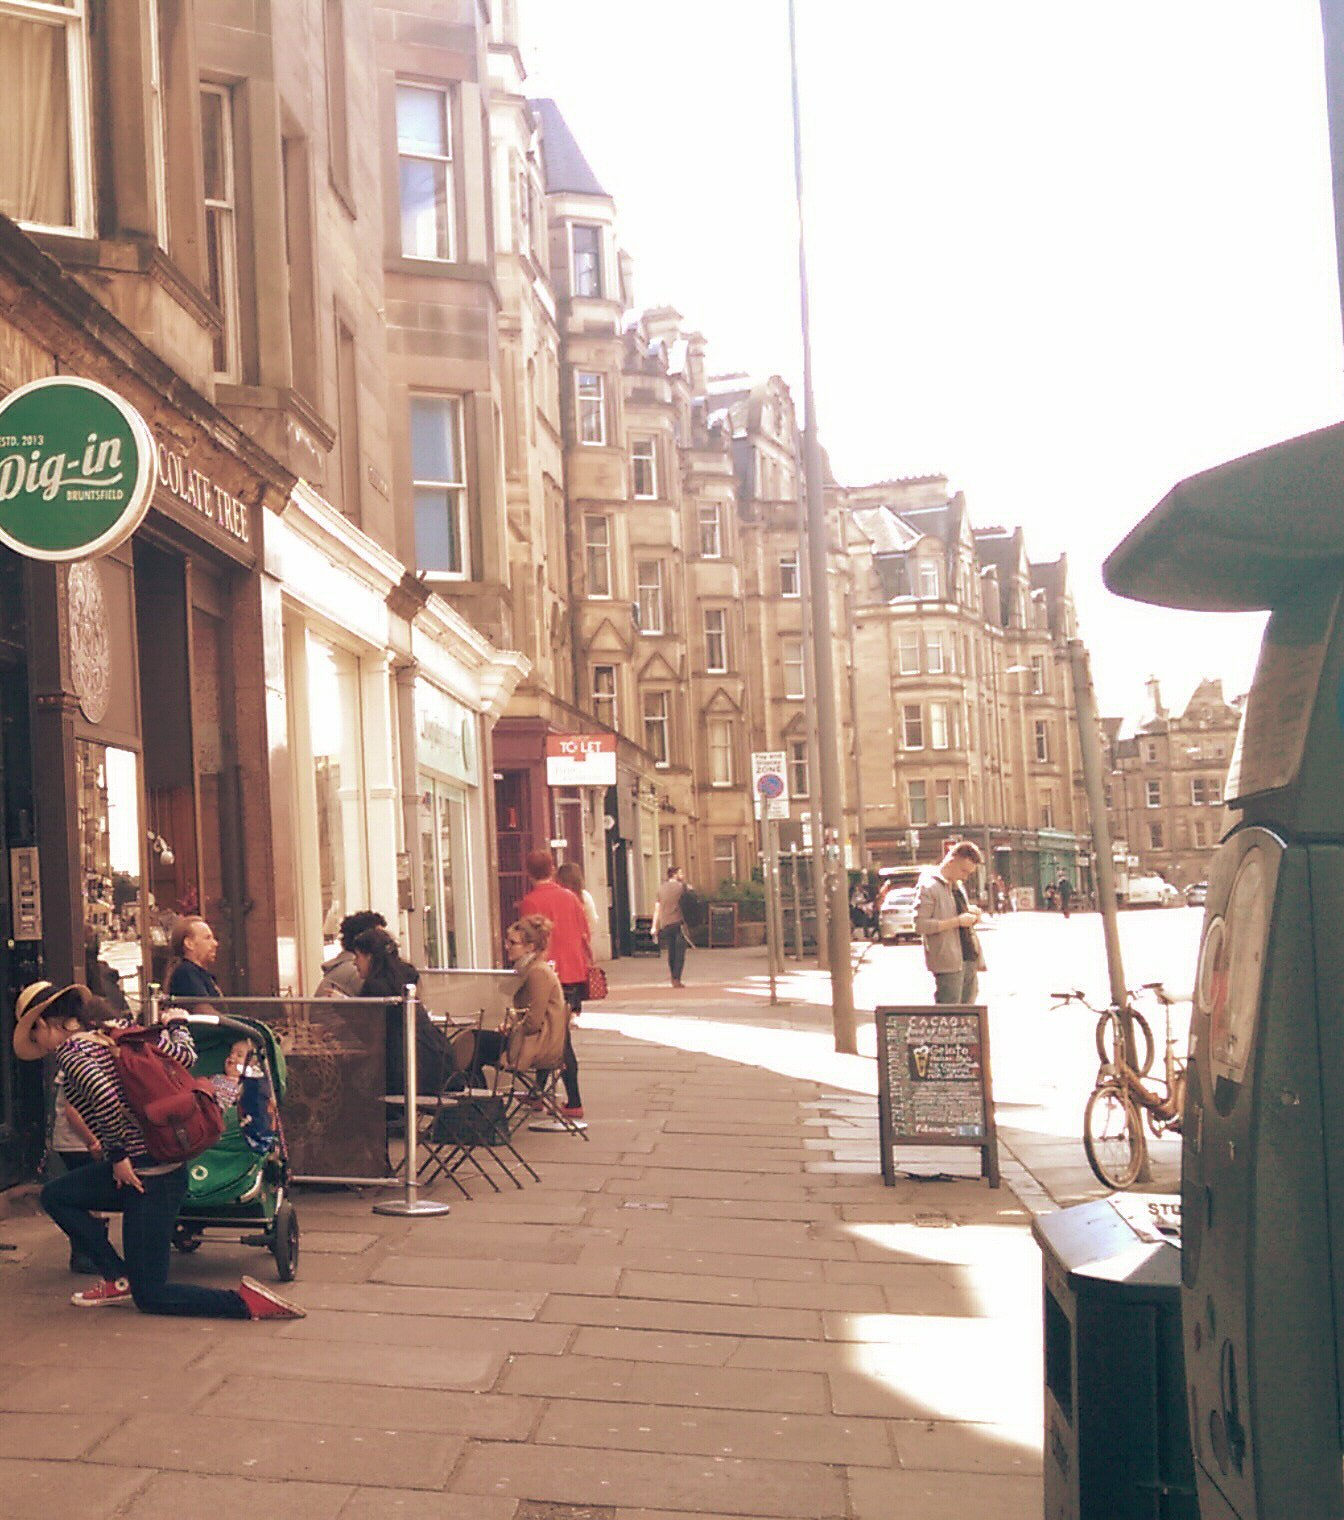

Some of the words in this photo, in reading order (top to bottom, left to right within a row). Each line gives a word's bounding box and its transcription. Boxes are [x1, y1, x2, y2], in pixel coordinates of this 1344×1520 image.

[22, 434, 44, 446] 2013
[66, 489, 123, 501] BRUNTSFIELD
[214, 485, 249, 542] TREE
[560, 741, 578, 753] TO
[580, 741, 601, 753] LET
